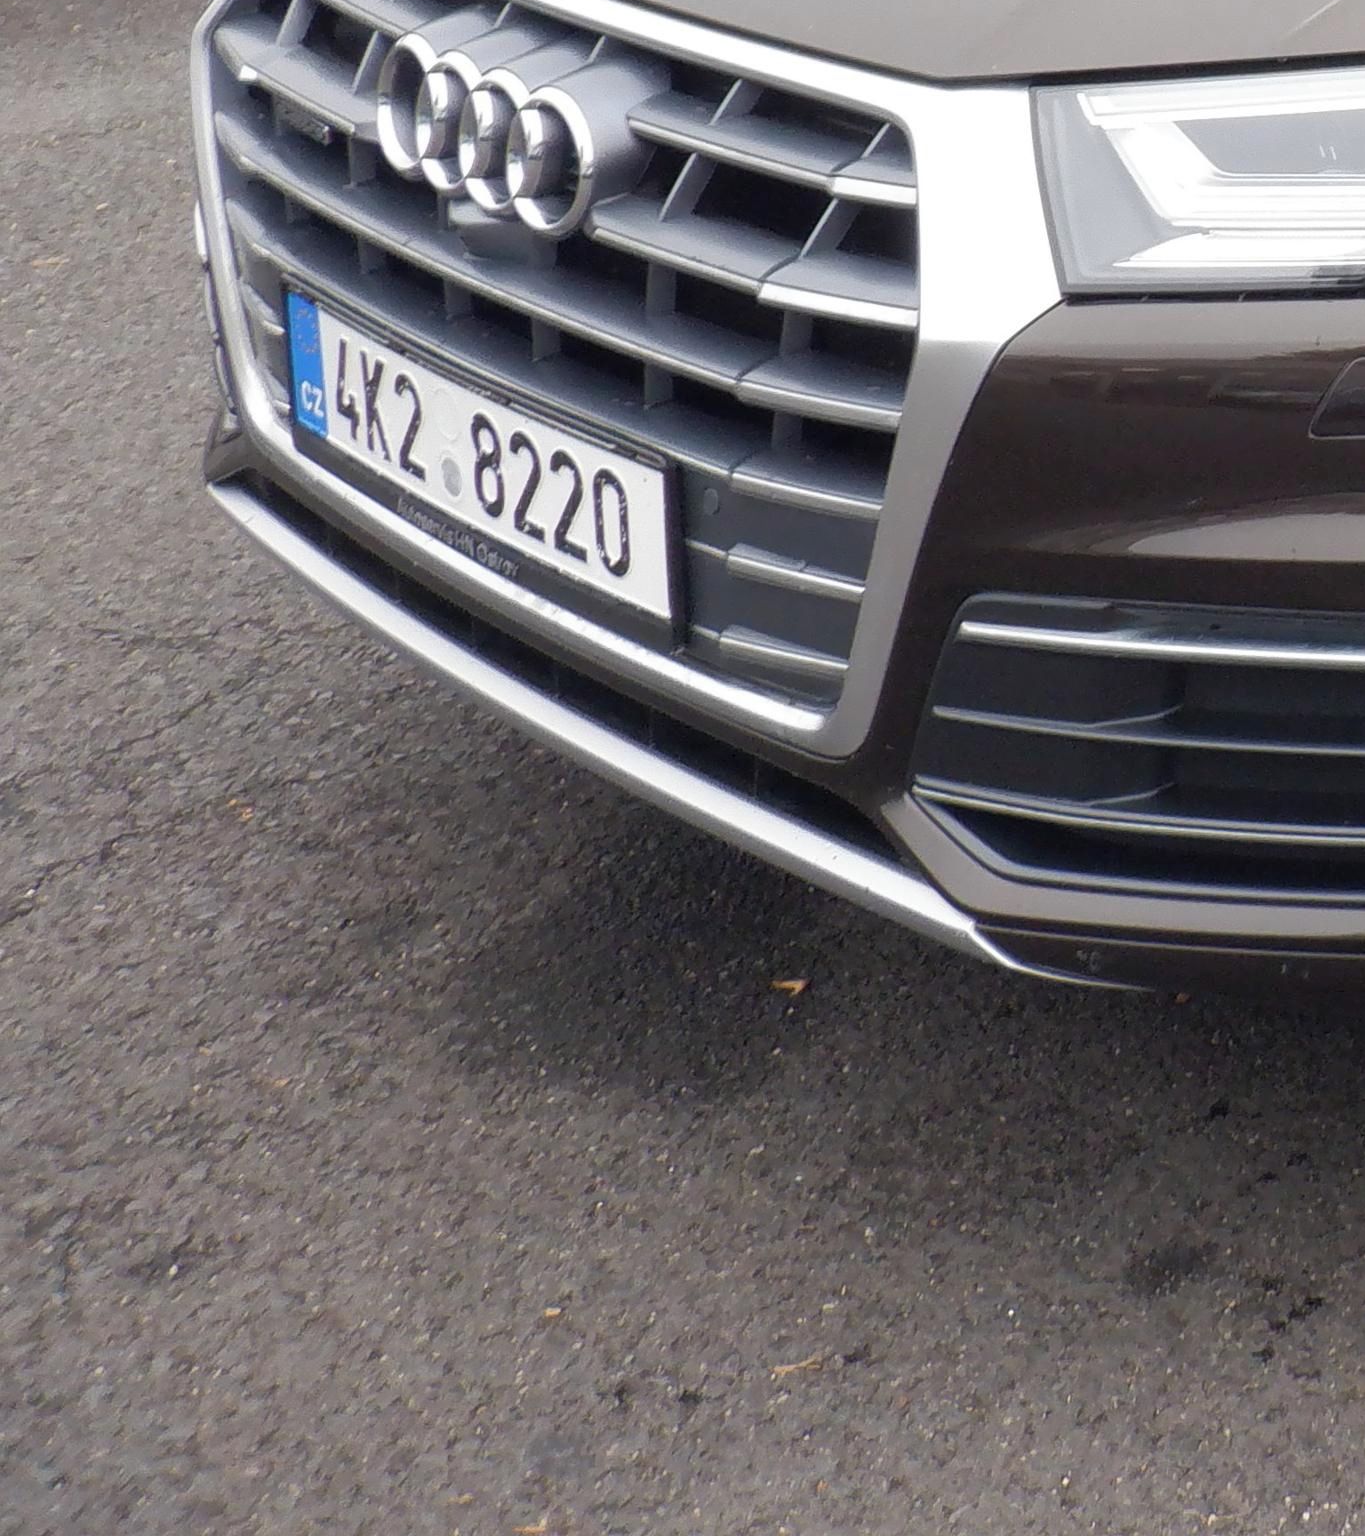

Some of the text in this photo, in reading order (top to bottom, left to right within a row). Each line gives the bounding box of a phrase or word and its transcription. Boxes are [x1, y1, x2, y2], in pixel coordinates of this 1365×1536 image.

[301, 380, 325, 417] CZ
[336, 336, 632, 577] 4K2 8220
